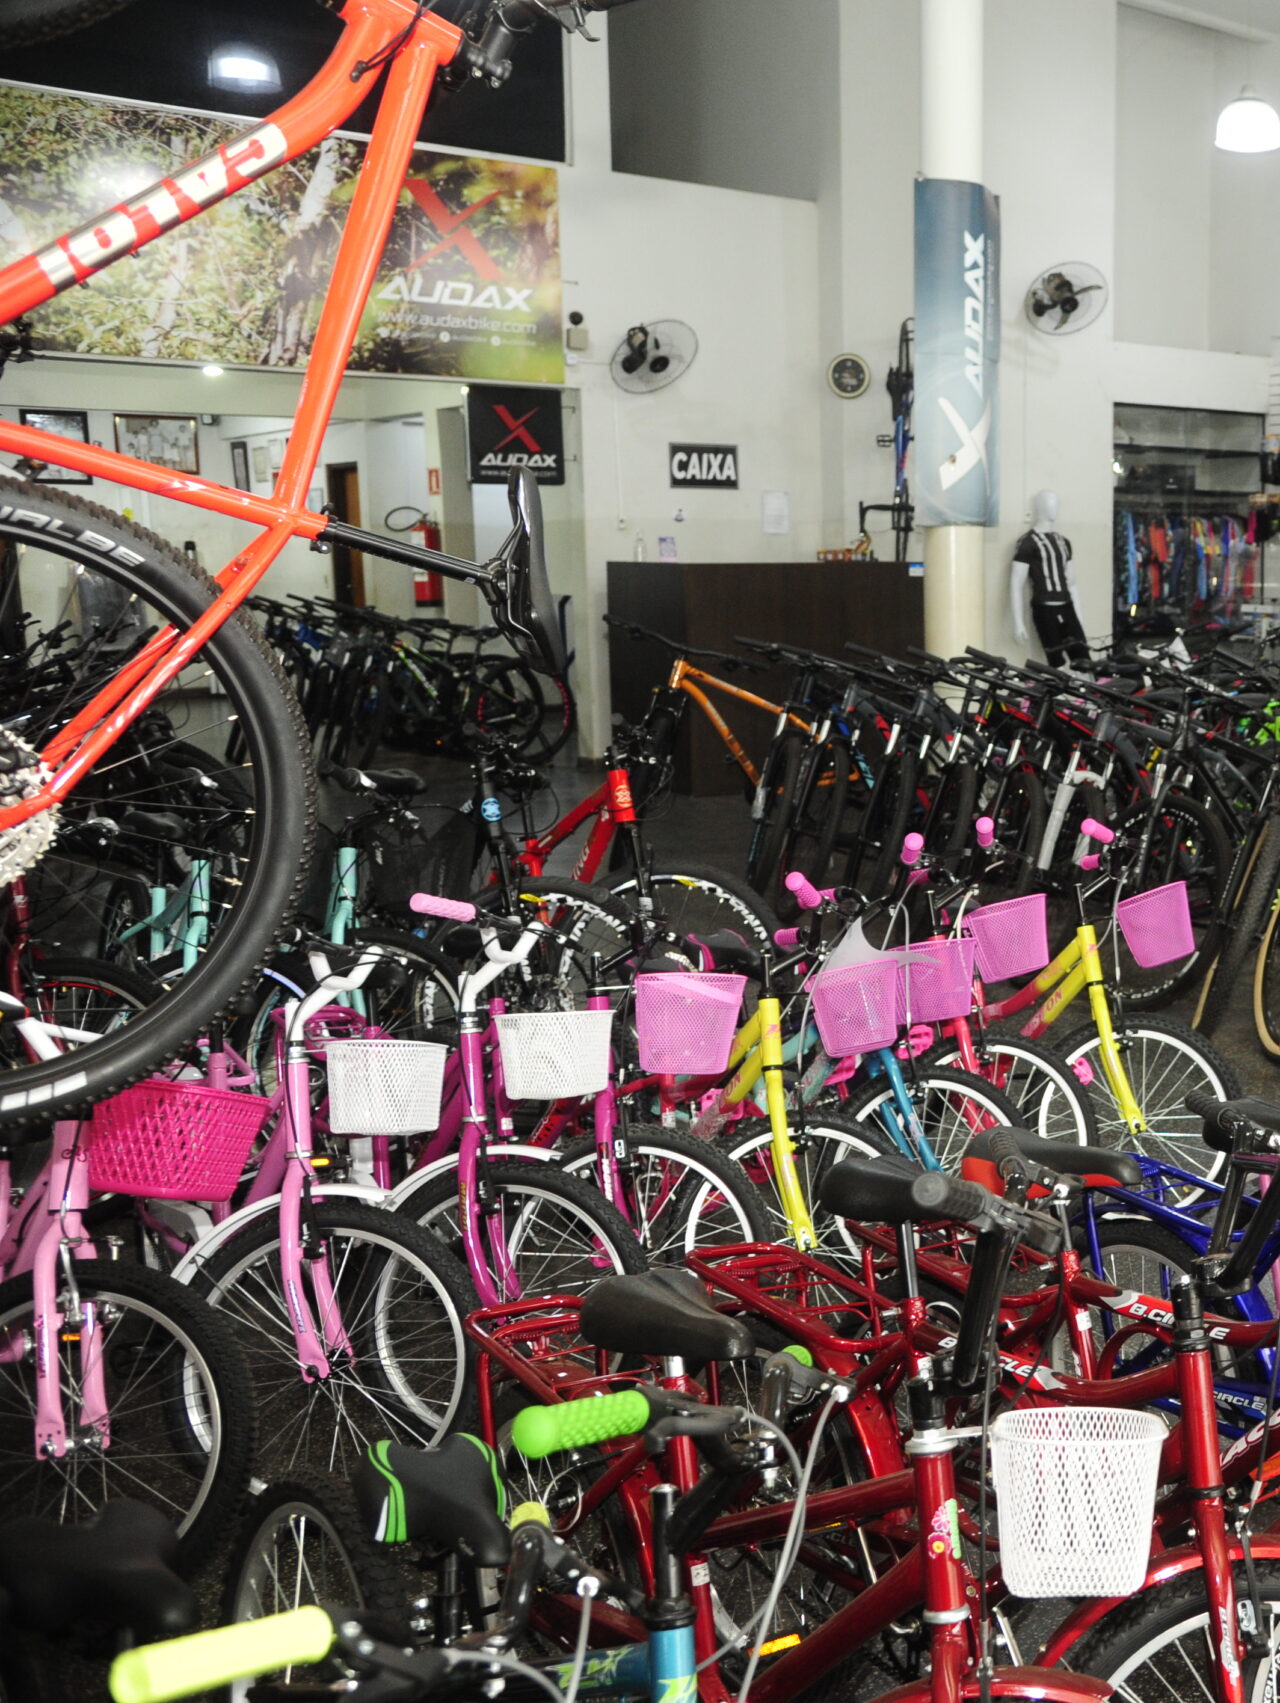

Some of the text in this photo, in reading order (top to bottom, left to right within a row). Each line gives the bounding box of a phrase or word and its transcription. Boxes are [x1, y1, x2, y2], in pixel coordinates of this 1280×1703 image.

[33, 122, 288, 294] CALOI
[377, 275, 533, 312] AUDAX
[377, 311, 537, 334] www.audaxbike.com
[963, 230, 985, 400] AUDAX
[479, 452, 557, 468] AUDAX
[671, 451, 737, 482] CAIXA
